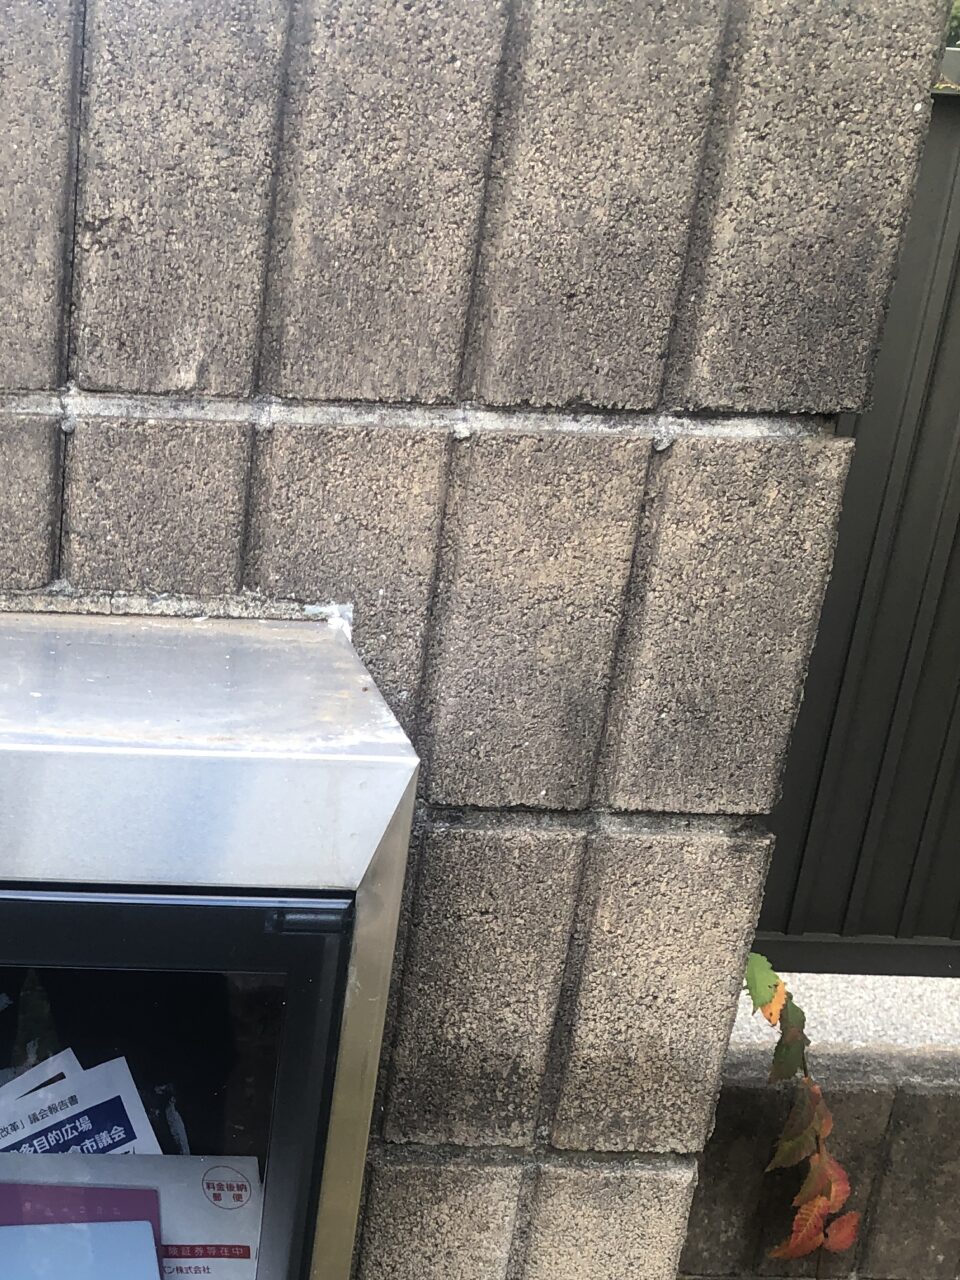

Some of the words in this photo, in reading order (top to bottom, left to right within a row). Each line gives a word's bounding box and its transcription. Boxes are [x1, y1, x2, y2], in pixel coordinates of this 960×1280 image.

[11, 1115, 93, 1154] 多目的広場
[206, 1182, 248, 1193] 料金後納
